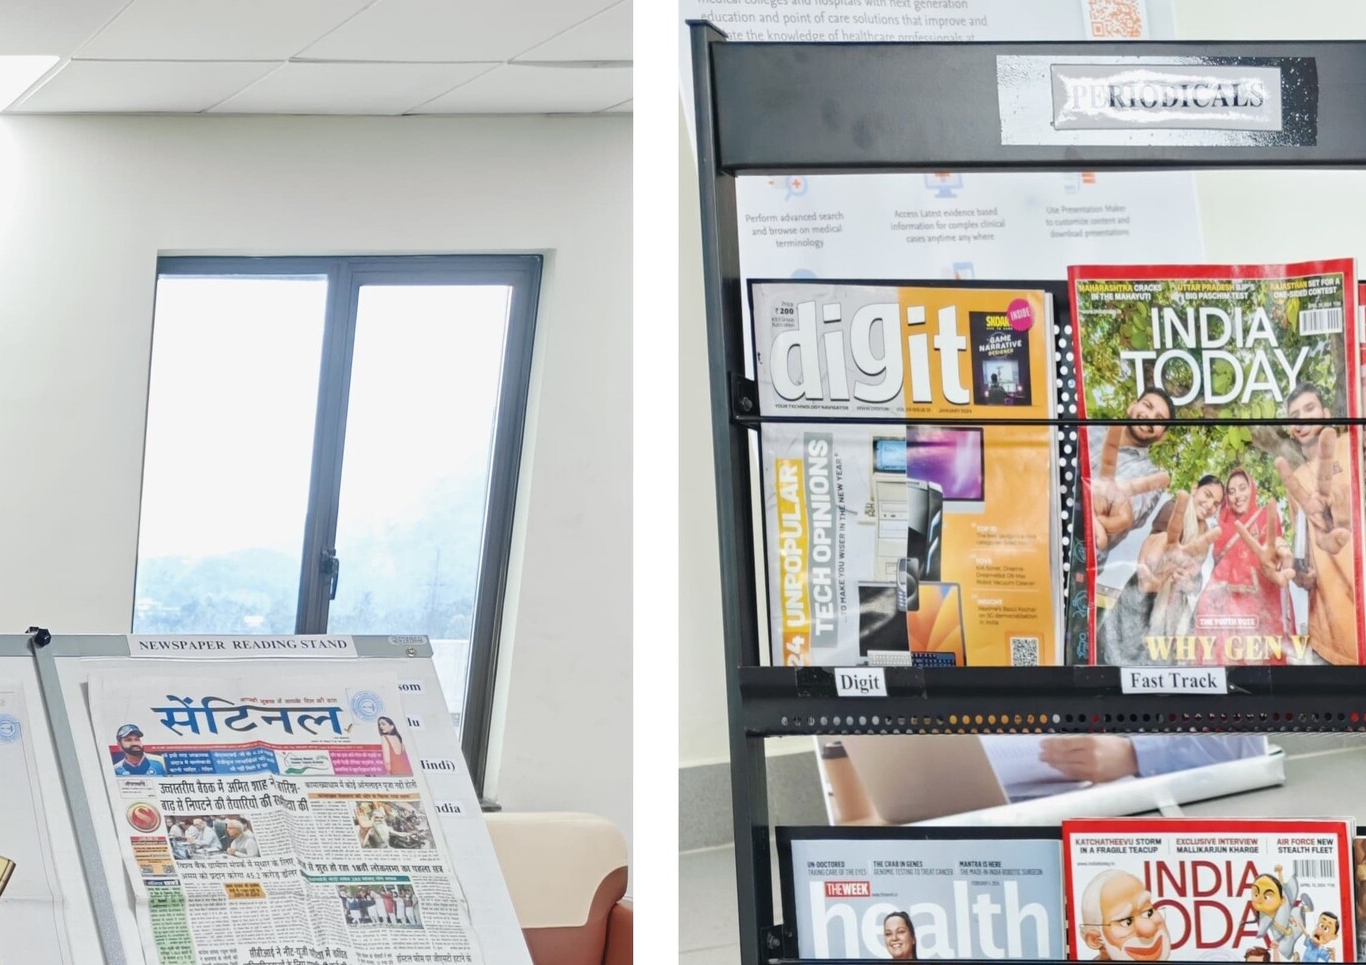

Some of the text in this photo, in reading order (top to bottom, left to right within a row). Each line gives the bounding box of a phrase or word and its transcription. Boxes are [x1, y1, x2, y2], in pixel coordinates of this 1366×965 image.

[783, 11, 967, 28] point of care solutions that improve
[1151, 308, 1279, 349] INDIA
[770, 301, 970, 404] digit
[1120, 346, 1310, 405] TODAY
[780, 464, 805, 627] UNPOPULAR
[809, 439, 834, 635] TECH OPINIONS
[139, 639, 348, 651] NEWSPAPER READING STAND
[841, 674, 880, 692] Digit
[1131, 671, 1217, 690] Fast Track
[150, 694, 344, 737] सेंटिनल
[226, 780, 249, 792] अमित
[252, 779, 267, 791] शाह
[1177, 846, 1259, 854] MALLIKARJUN KHARGE
[1278, 846, 1333, 854] STEALTH FLEET
